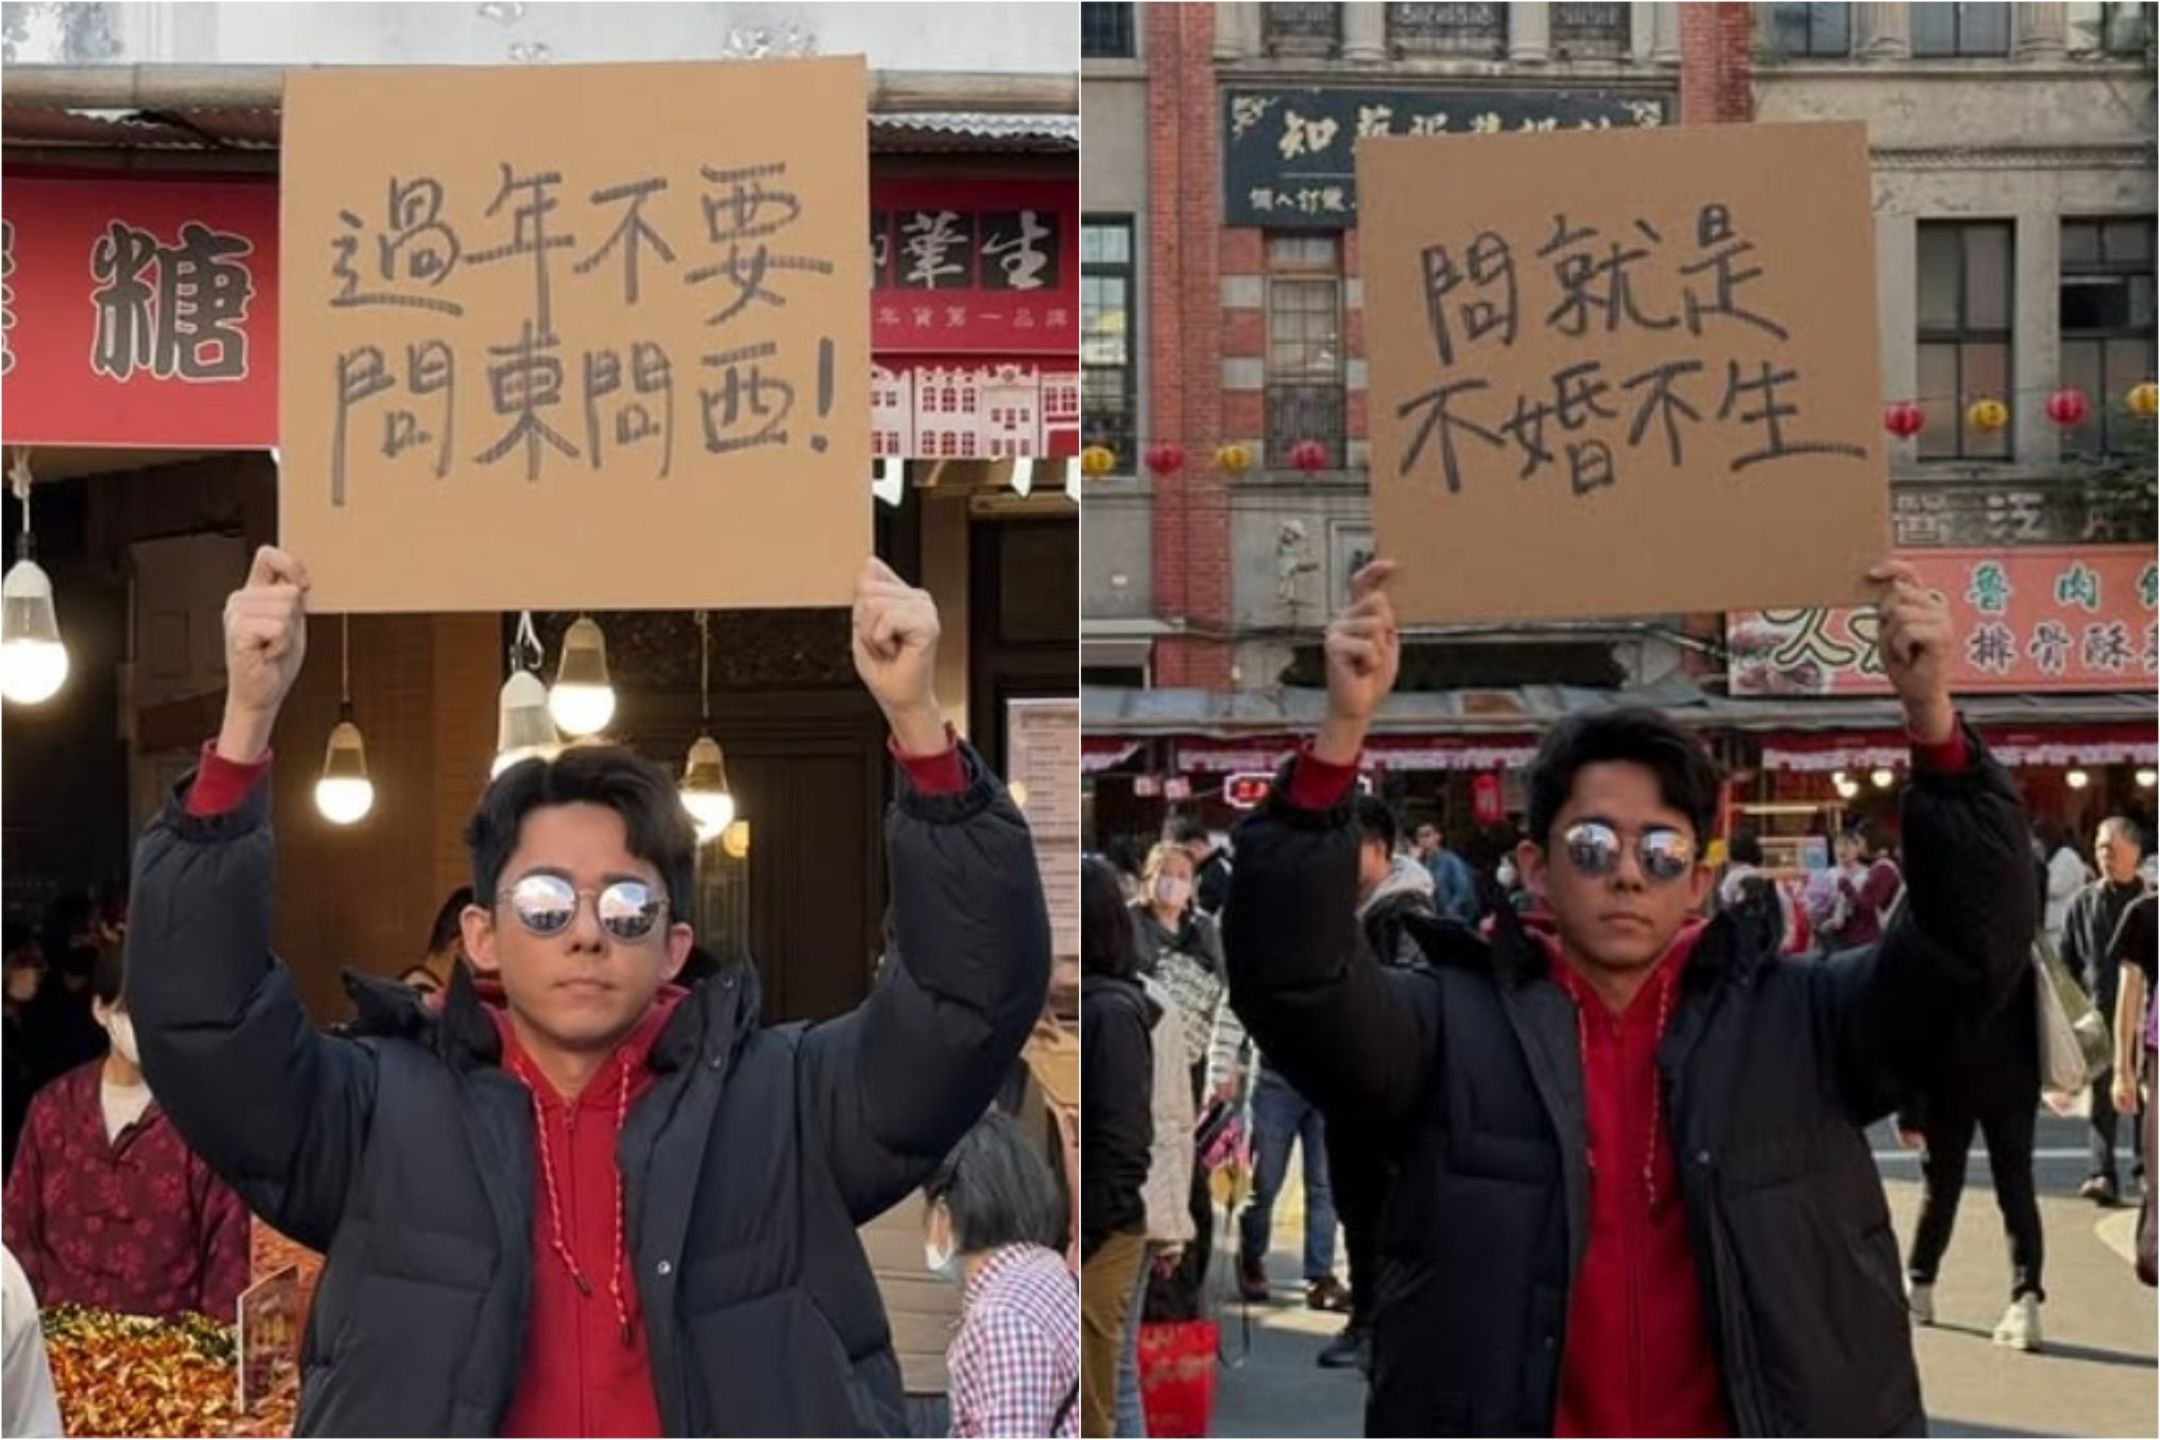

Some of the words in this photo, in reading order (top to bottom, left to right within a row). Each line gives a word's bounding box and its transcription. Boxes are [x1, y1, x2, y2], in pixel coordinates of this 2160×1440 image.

[330, 163, 834, 335] 過年不要
[1421, 203, 1790, 366] 問就是
[1397, 361, 1868, 495] 不婚不生
